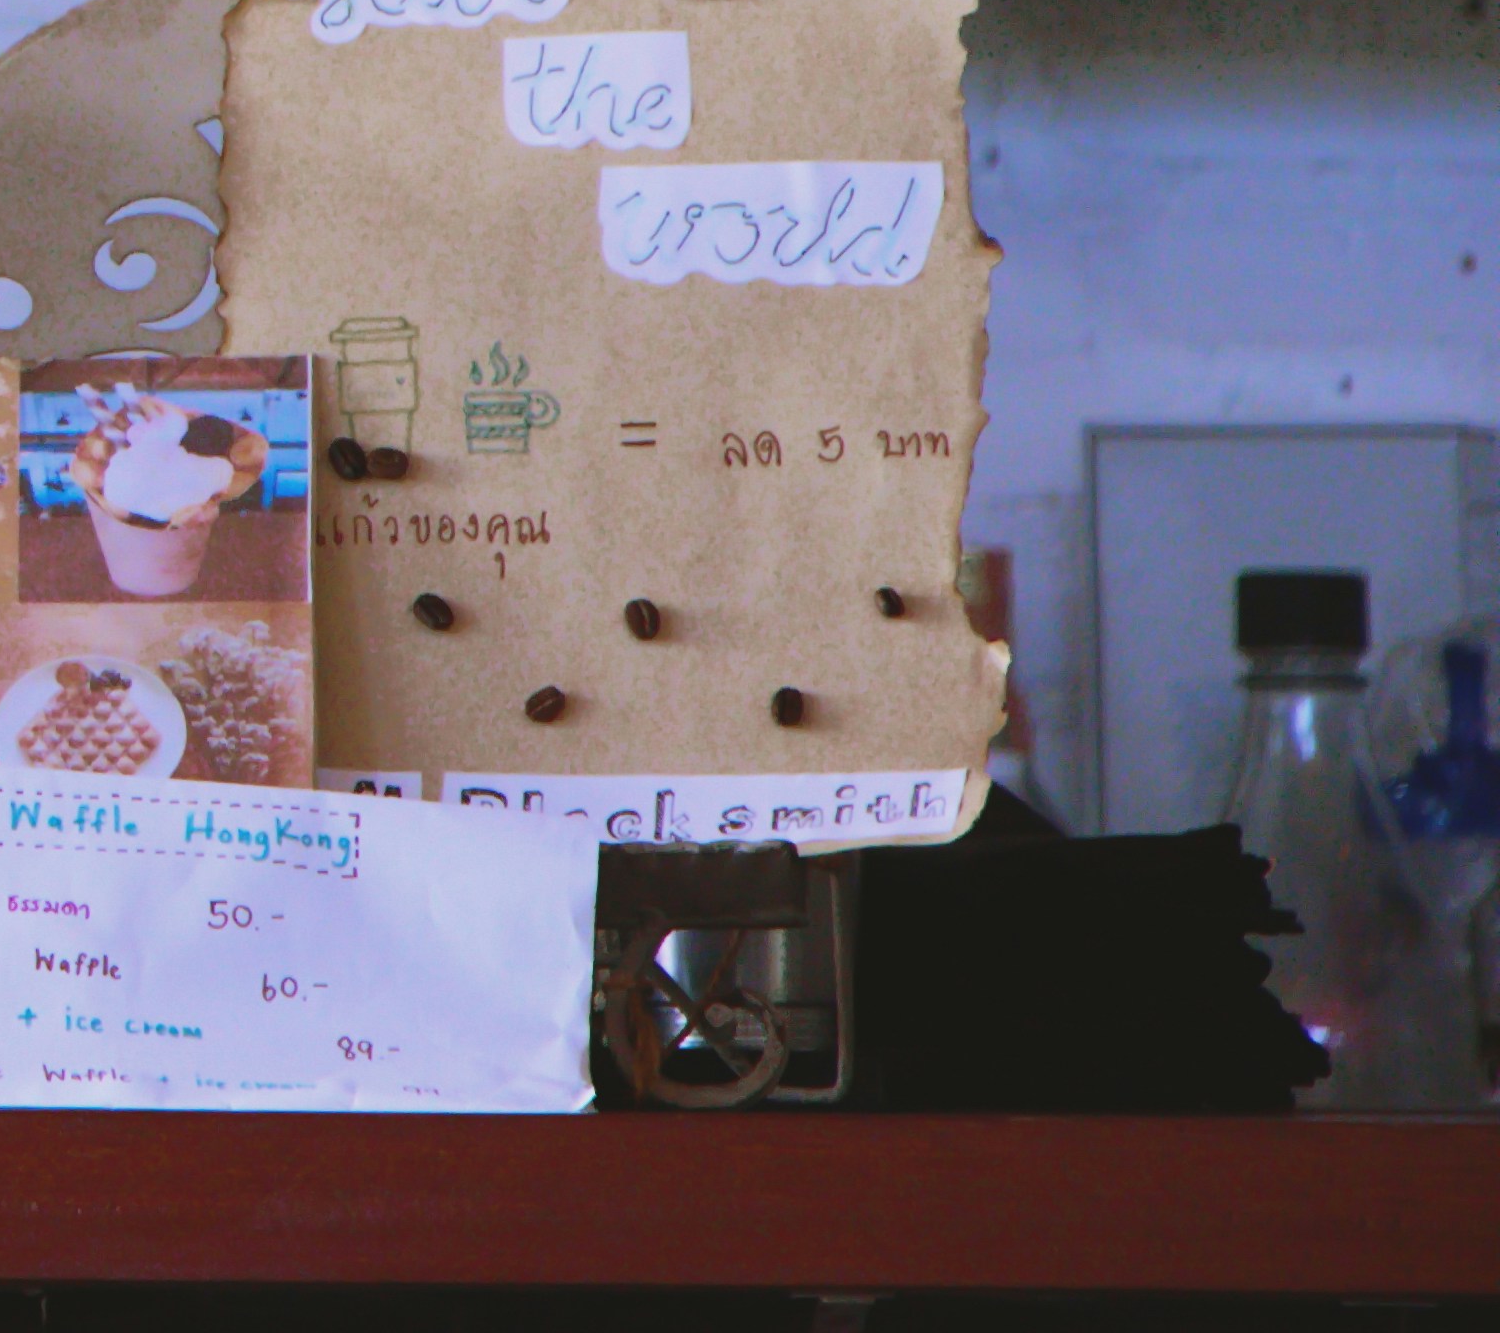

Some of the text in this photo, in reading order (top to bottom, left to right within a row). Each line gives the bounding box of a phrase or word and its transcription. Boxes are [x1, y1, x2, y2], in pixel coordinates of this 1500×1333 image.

[511, 41, 673, 137] the
[615, 177, 918, 278] world
[721, 430, 782, 468] ลด
[816, 425, 845, 464] 5
[876, 428, 952, 459] บาท
[10, 801, 138, 835] Waffle
[7, 895, 91, 920] ธรรมดา
[34, 947, 122, 981] Waffle
[64, 1005, 104, 1033] ice
